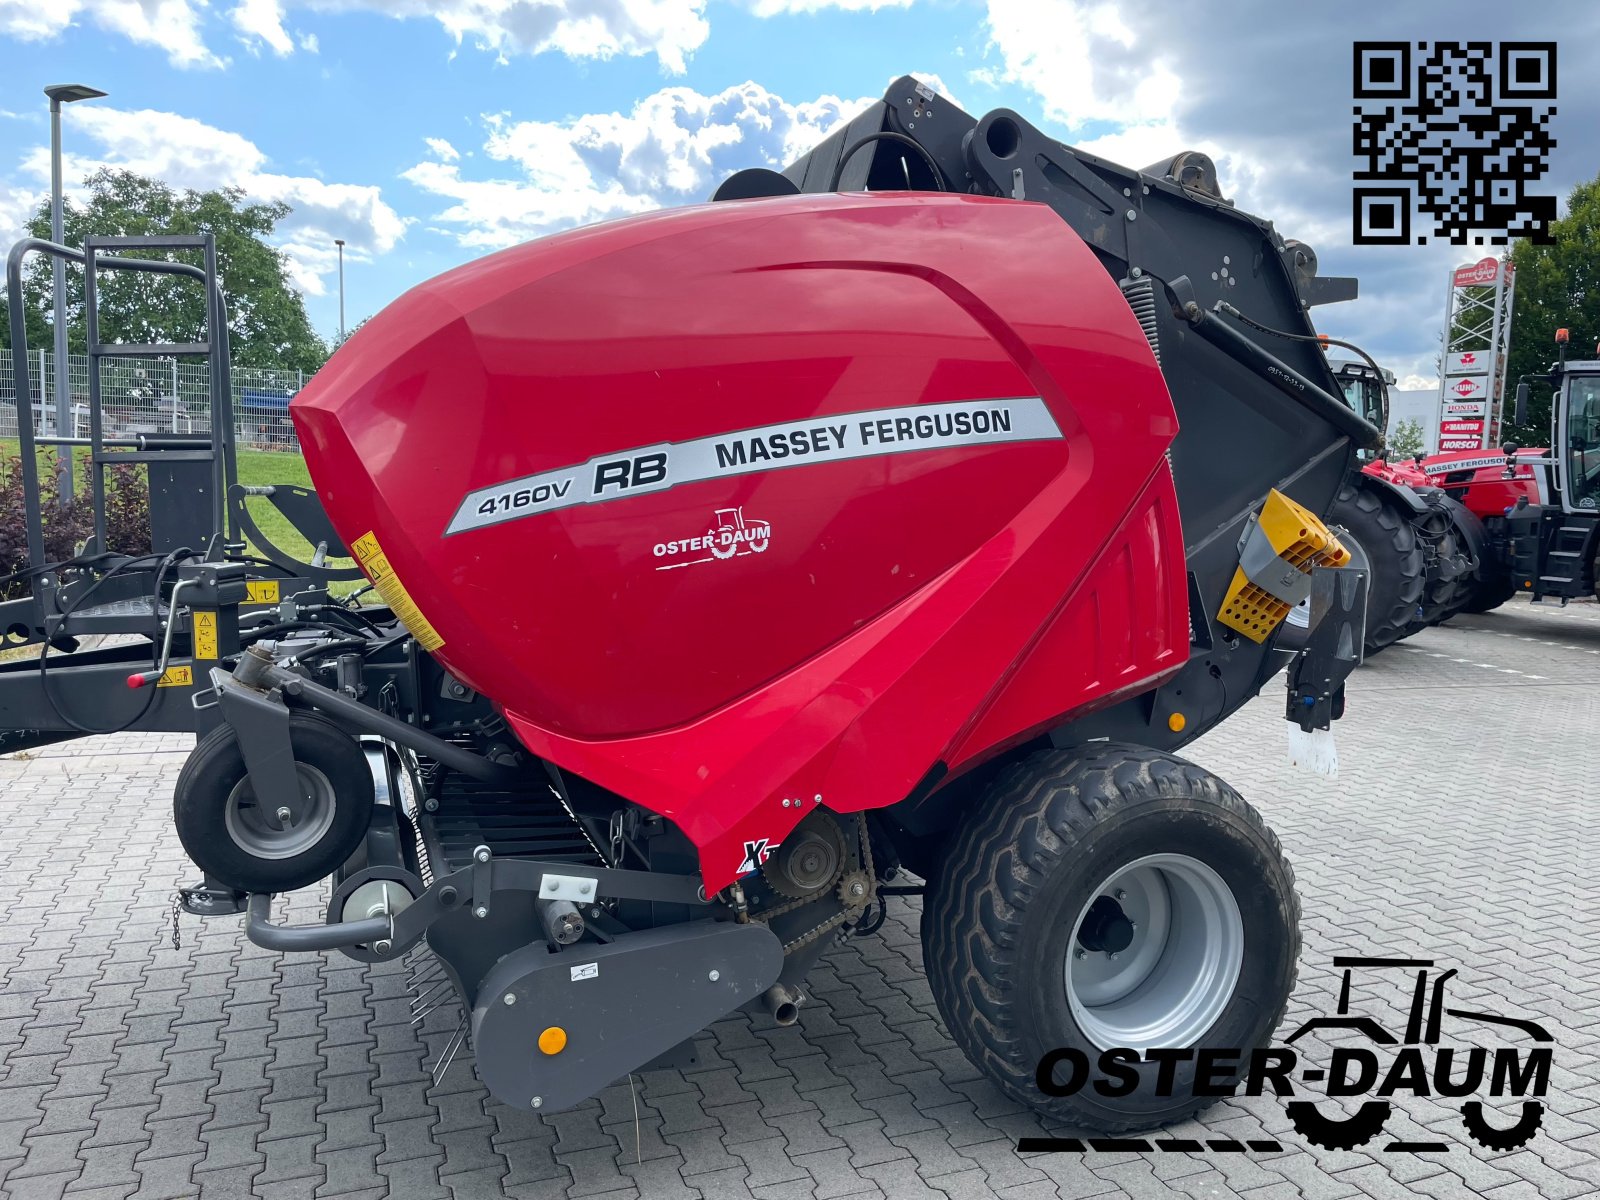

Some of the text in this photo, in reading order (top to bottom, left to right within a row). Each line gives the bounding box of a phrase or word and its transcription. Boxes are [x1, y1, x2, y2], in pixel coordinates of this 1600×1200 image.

[1455, 384, 1476, 392] KUHN
[1450, 423, 1480, 431] MANITOU
[715, 409, 1011, 468] MASSEY FERGUSON
[1442, 441, 1479, 449] HORSCH
[478, 452, 667, 515] 4160V RB
[653, 526, 771, 557] OSTER-DAUM
